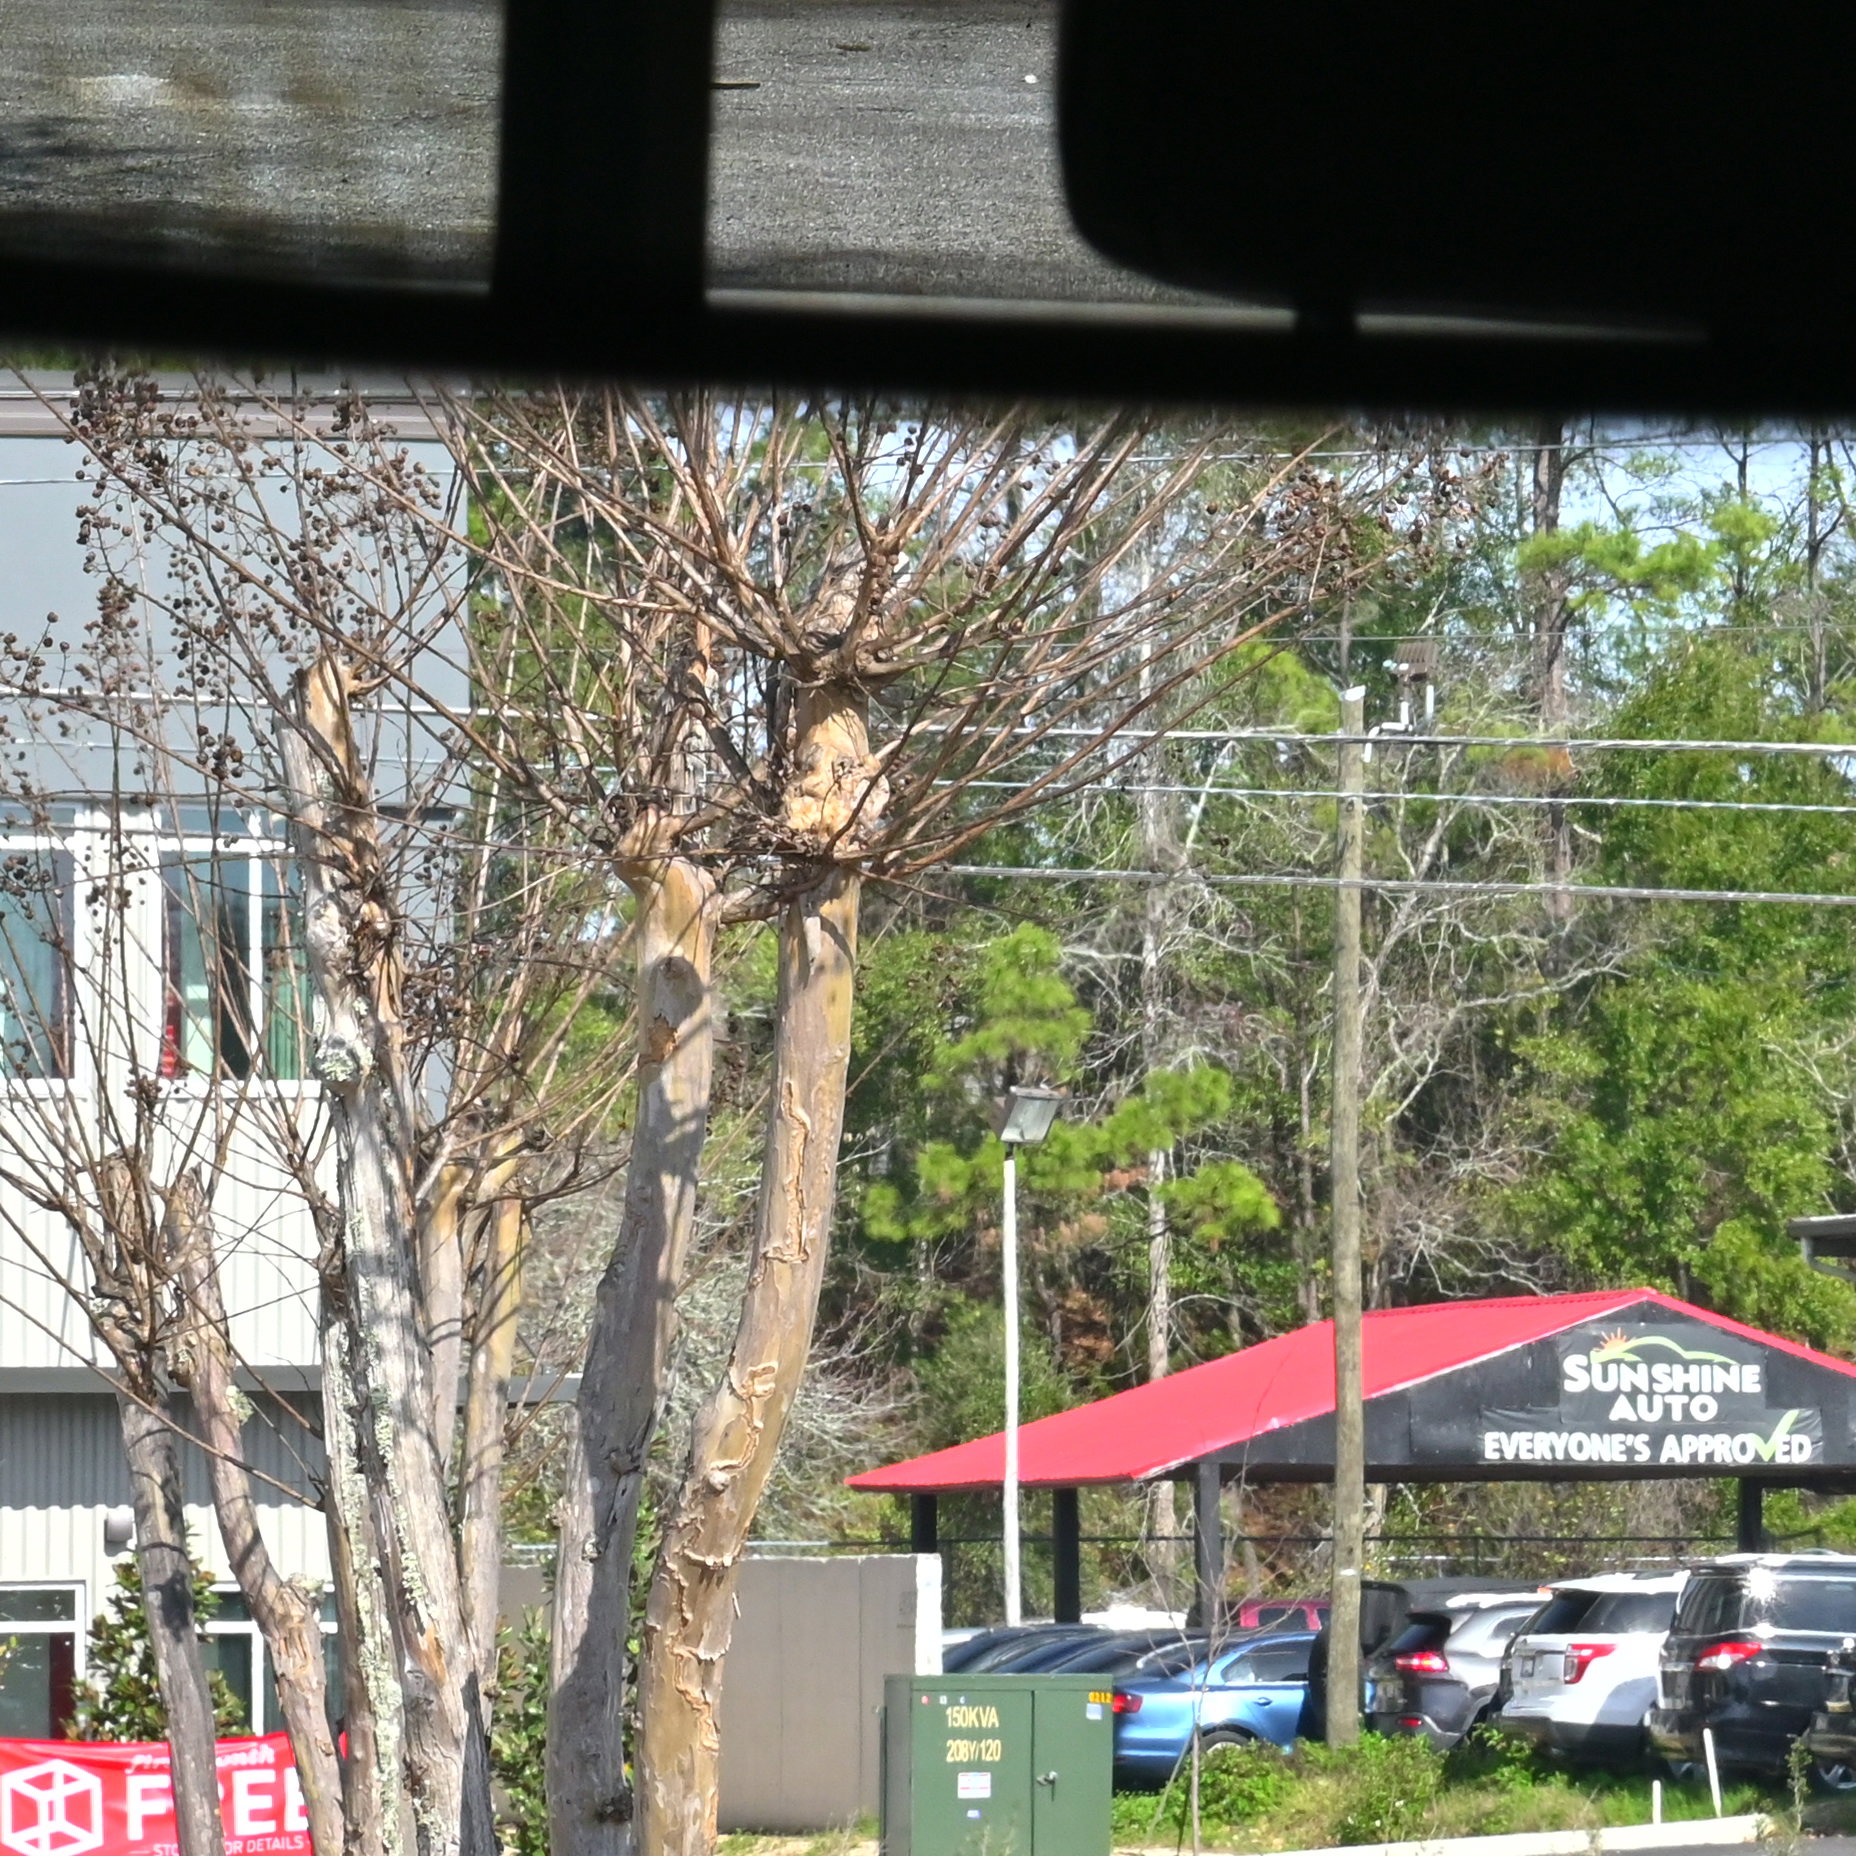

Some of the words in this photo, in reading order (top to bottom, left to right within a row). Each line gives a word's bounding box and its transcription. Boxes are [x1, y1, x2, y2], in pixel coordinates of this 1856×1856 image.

[1563, 1354, 1761, 1393] SUNSHINE
[1608, 1394, 1718, 1422] AUTO
[1484, 1431, 1651, 1463] EVERYONE'S
[1659, 1410, 1812, 1463] APPROVED
[946, 1706, 999, 1728] 150KVA
[946, 1739, 1002, 1762] 208Y/120
[126, 1767, 308, 1841] FEE
[247, 1835, 304, 1852] DETAILS
